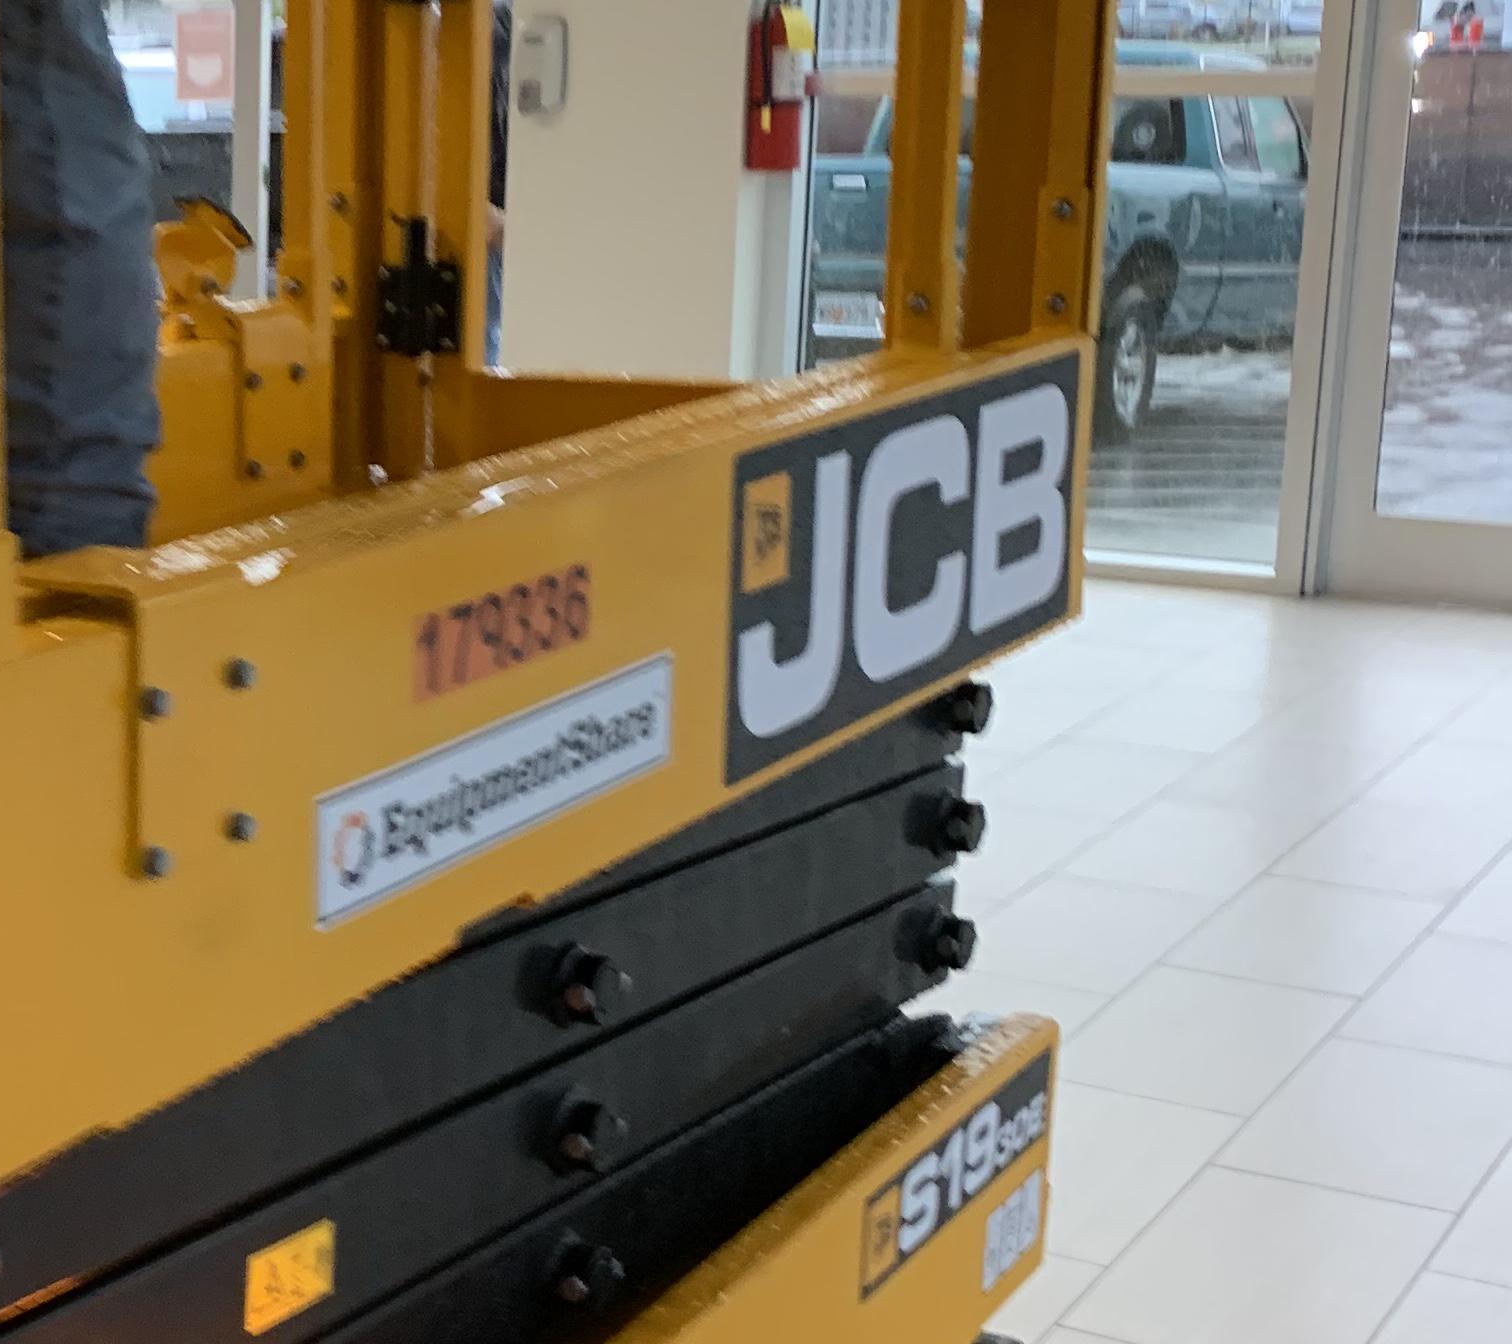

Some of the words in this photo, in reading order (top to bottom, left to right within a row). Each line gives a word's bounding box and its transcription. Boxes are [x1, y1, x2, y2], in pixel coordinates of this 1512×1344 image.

[417, 564, 589, 696] 179336
[738, 383, 1069, 738] JCB
[381, 701, 655, 857] EquipmentShare
